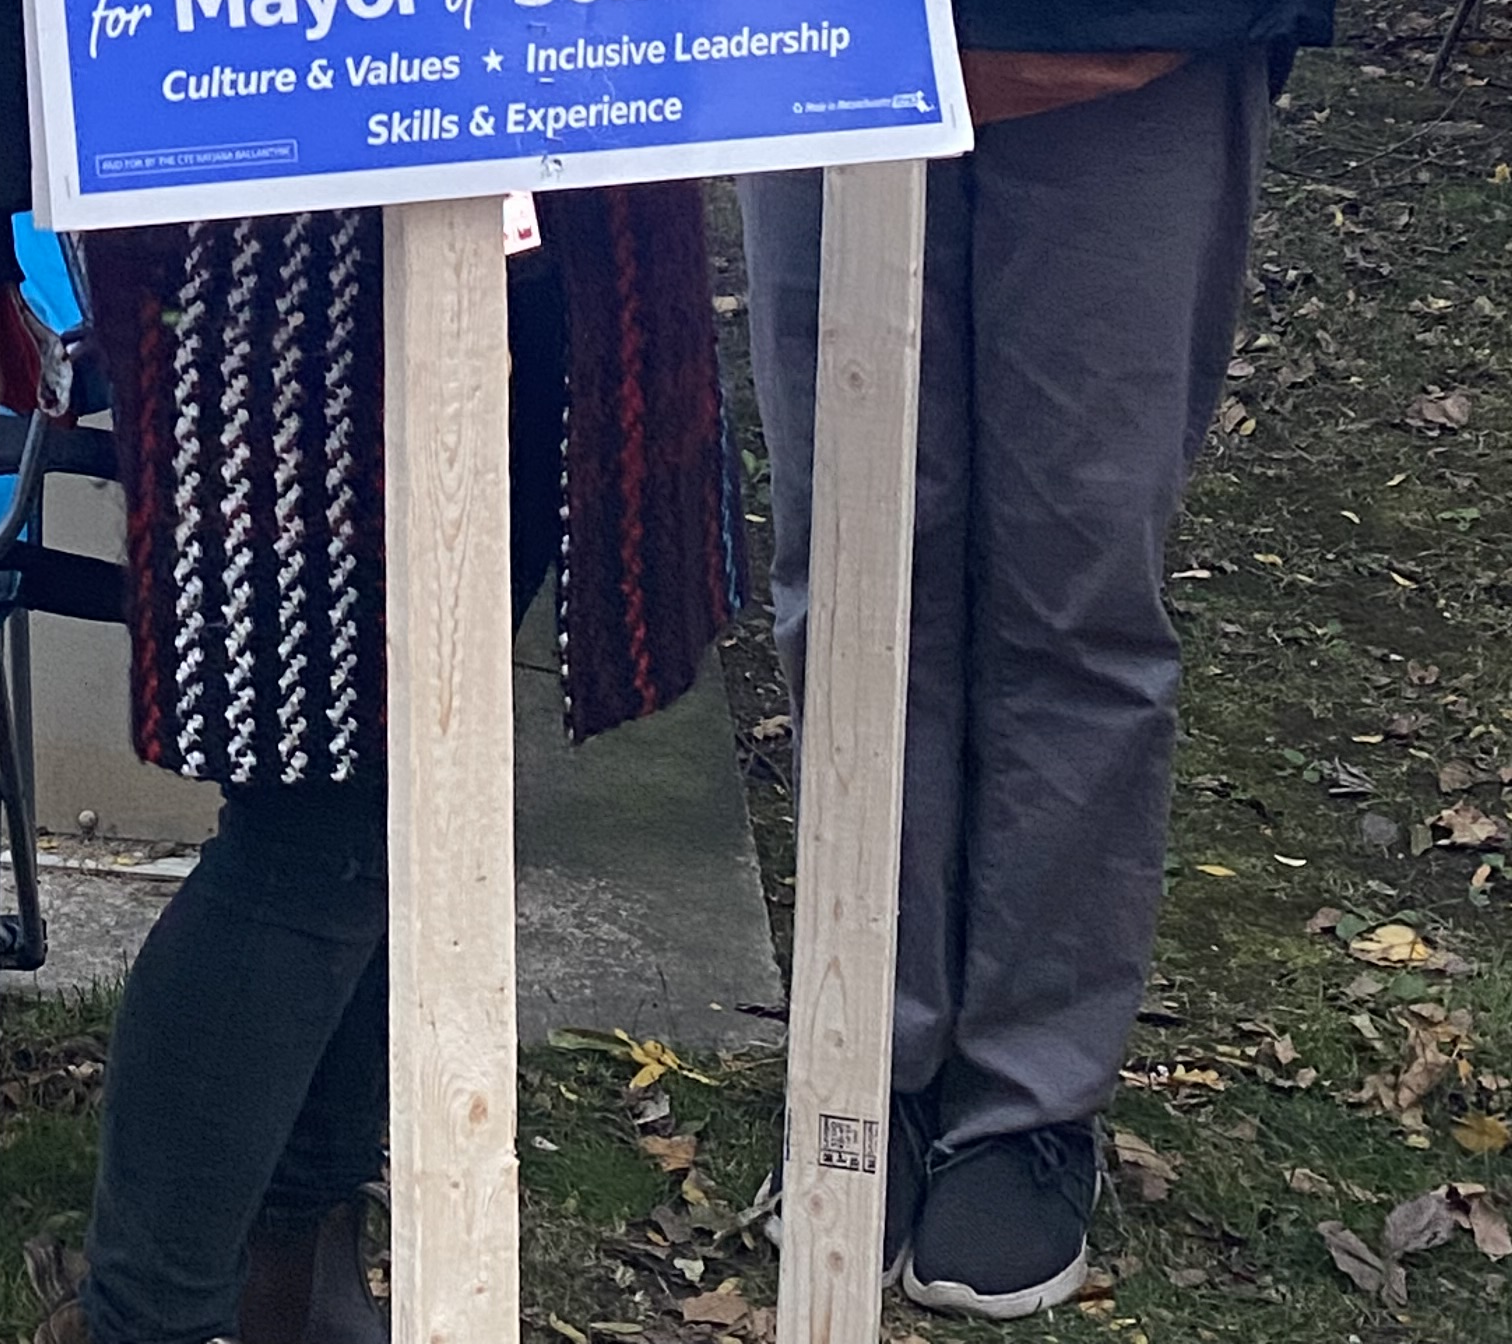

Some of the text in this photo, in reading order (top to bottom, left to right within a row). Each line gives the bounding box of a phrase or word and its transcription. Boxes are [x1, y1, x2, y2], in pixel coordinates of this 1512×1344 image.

[161, 21, 851, 103] Culture & Values Inclusive Leadership
[367, 92, 682, 146] Skills & Experience
